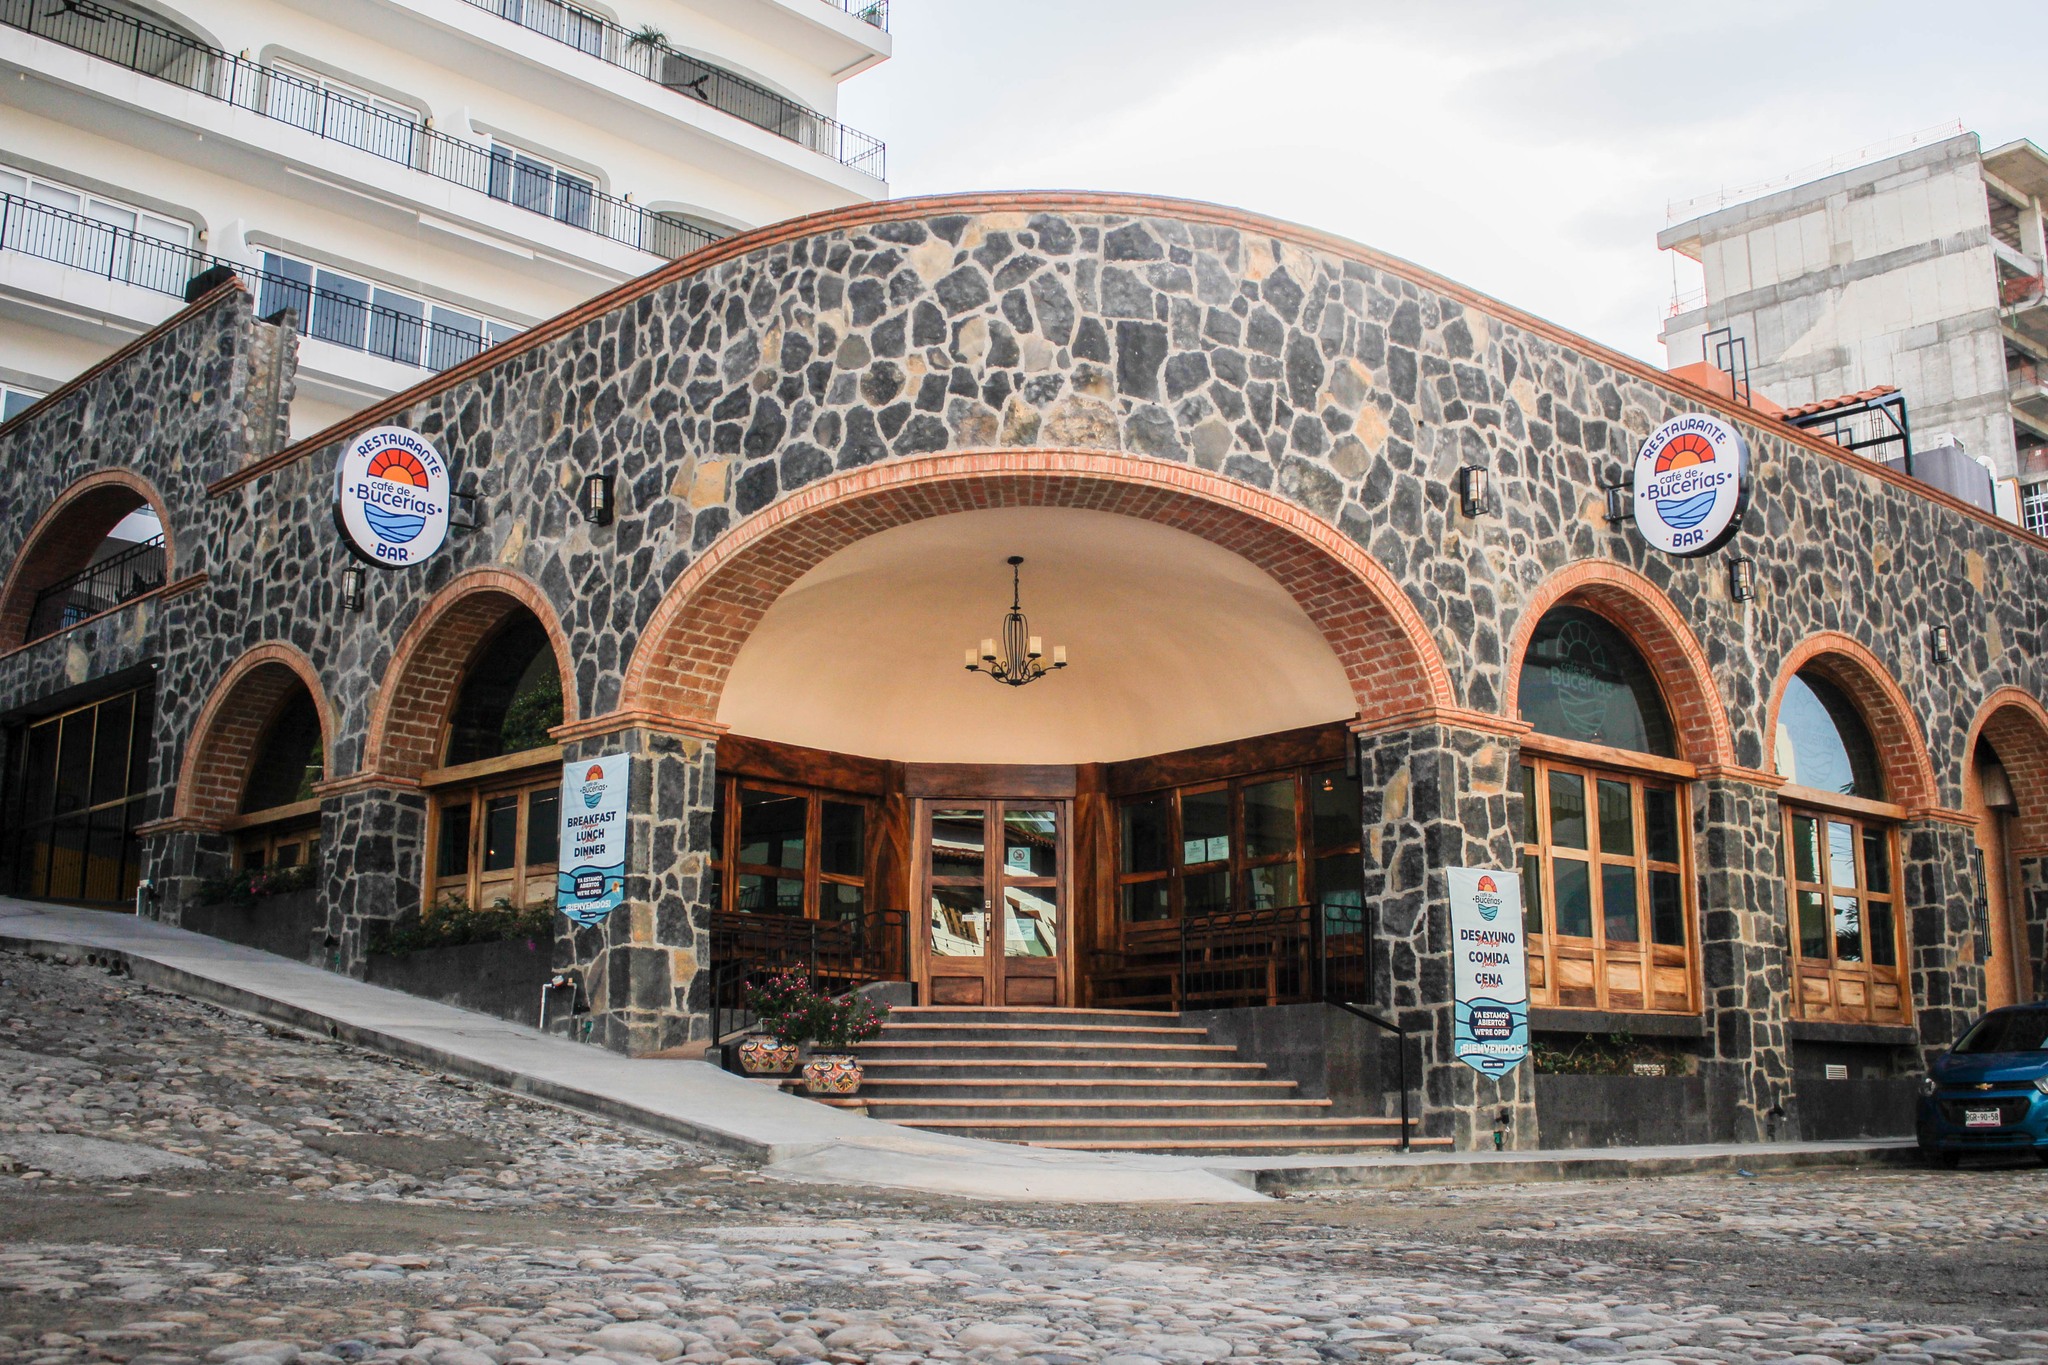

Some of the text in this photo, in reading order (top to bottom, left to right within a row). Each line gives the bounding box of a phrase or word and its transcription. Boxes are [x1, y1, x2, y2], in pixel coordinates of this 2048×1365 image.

[1643, 418, 1727, 459] RESTAURANTE
[357, 433, 442, 476] RESTAURANTE
[1659, 469, 1698, 485] café de
[371, 481, 411, 496] café de
[1648, 472, 1725, 500] Bucerías
[357, 483, 436, 516] Bucerías
[1672, 529, 1704, 547] BAR
[375, 542, 408, 561] BAR
[1551, 665, 1613, 698] Bucerías
[567, 811, 617, 828] BREAKFAST
[576, 828, 605, 841] LUNCH
[574, 844, 606, 857] DINNER
[1460, 929, 1516, 944] DESAYUNO
[1468, 951, 1510, 964] COMIDA
[1475, 973, 1504, 985] CENA
[1473, 1011, 1510, 1019] YA ESTAMOS
[1474, 1028, 1493, 1036] WE'RE
[1459, 1043, 1524, 1056] ¡BIENVENIDOS!
